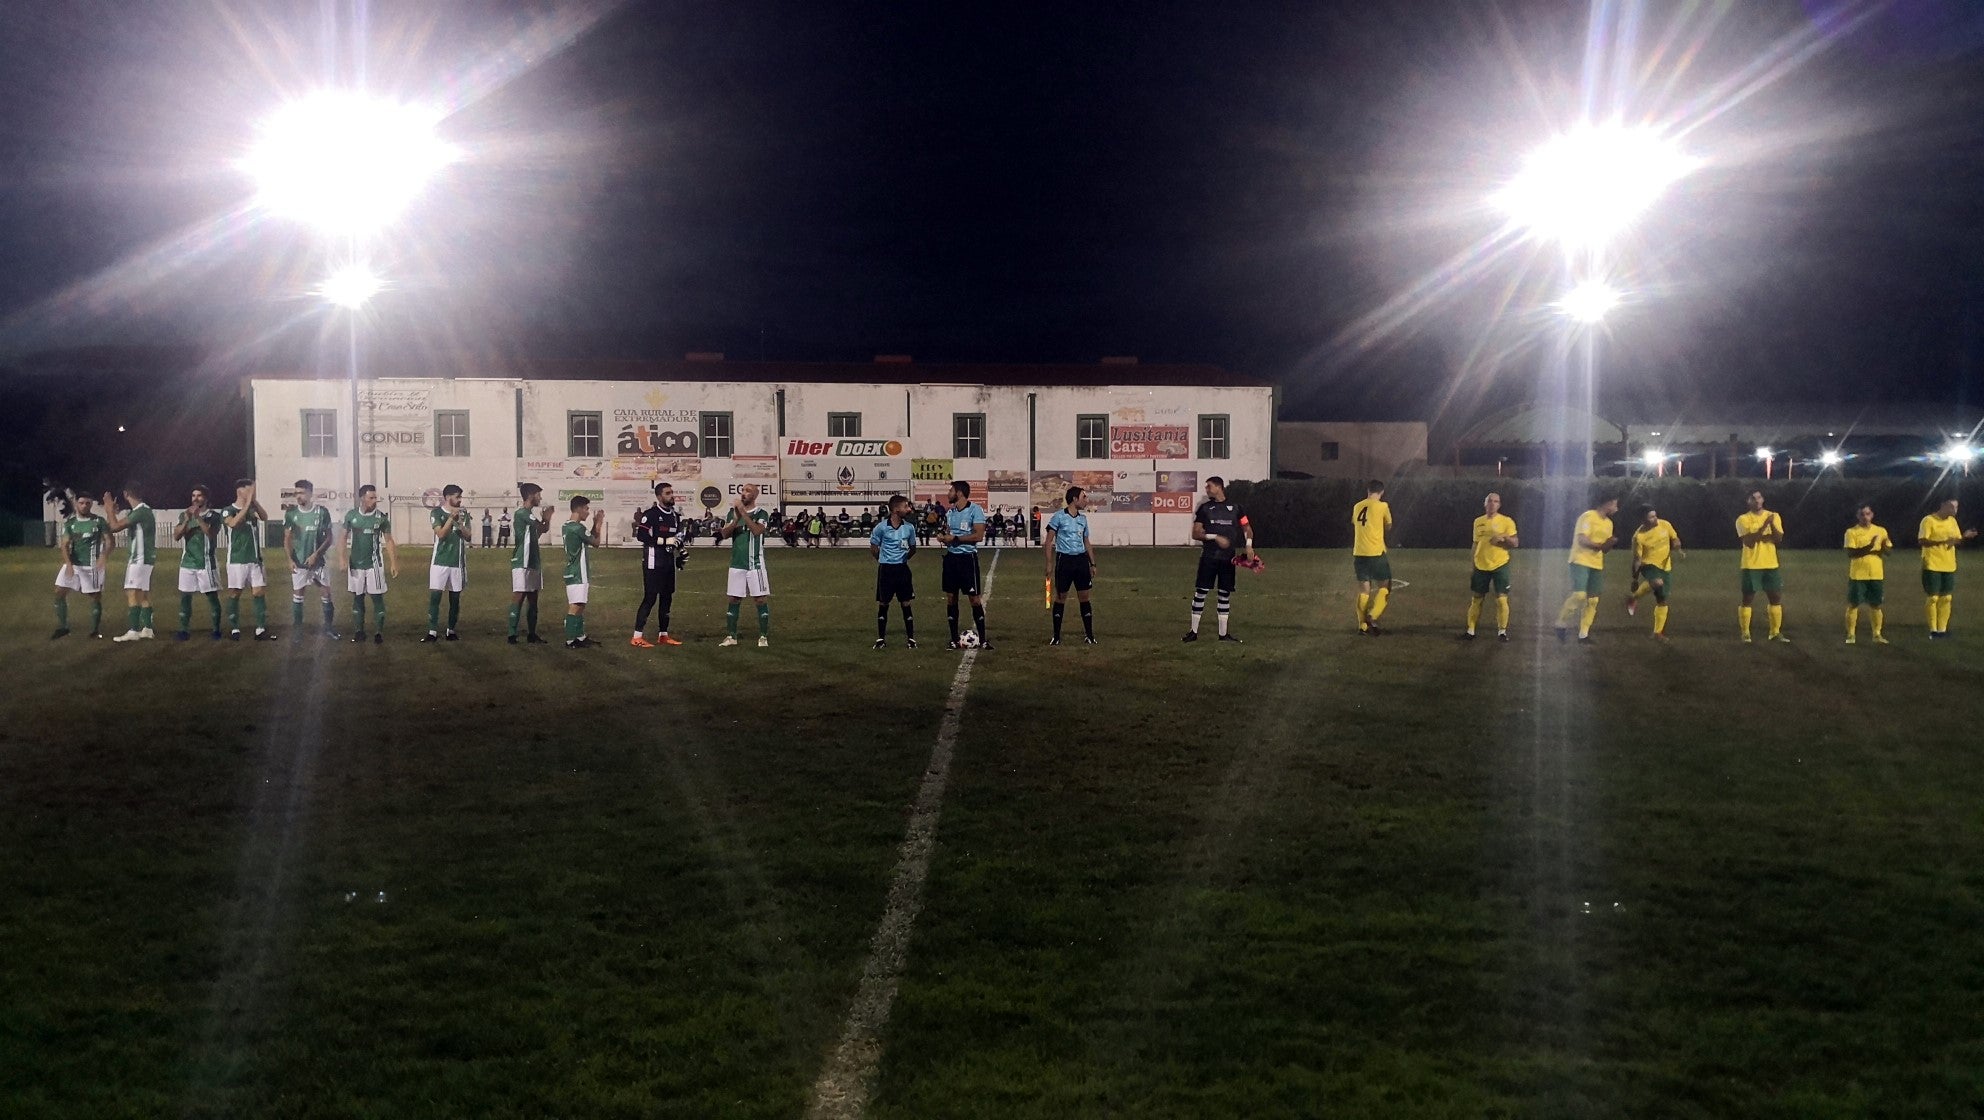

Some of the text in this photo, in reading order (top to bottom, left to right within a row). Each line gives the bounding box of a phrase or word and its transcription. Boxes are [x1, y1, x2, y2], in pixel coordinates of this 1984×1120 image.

[641, 409, 675, 417] RURAL
[680, 409, 697, 417] DE
[361, 432, 426, 444] CONDE
[617, 424, 698, 457] ático
[1112, 427, 1188, 442] Lusitania
[787, 440, 834, 456] iber
[1111, 440, 1145, 453] Cars
[527, 461, 564, 469] MAPFRE
[1111, 495, 1131, 503] MGS
[1357, 506, 1368, 527] 4
